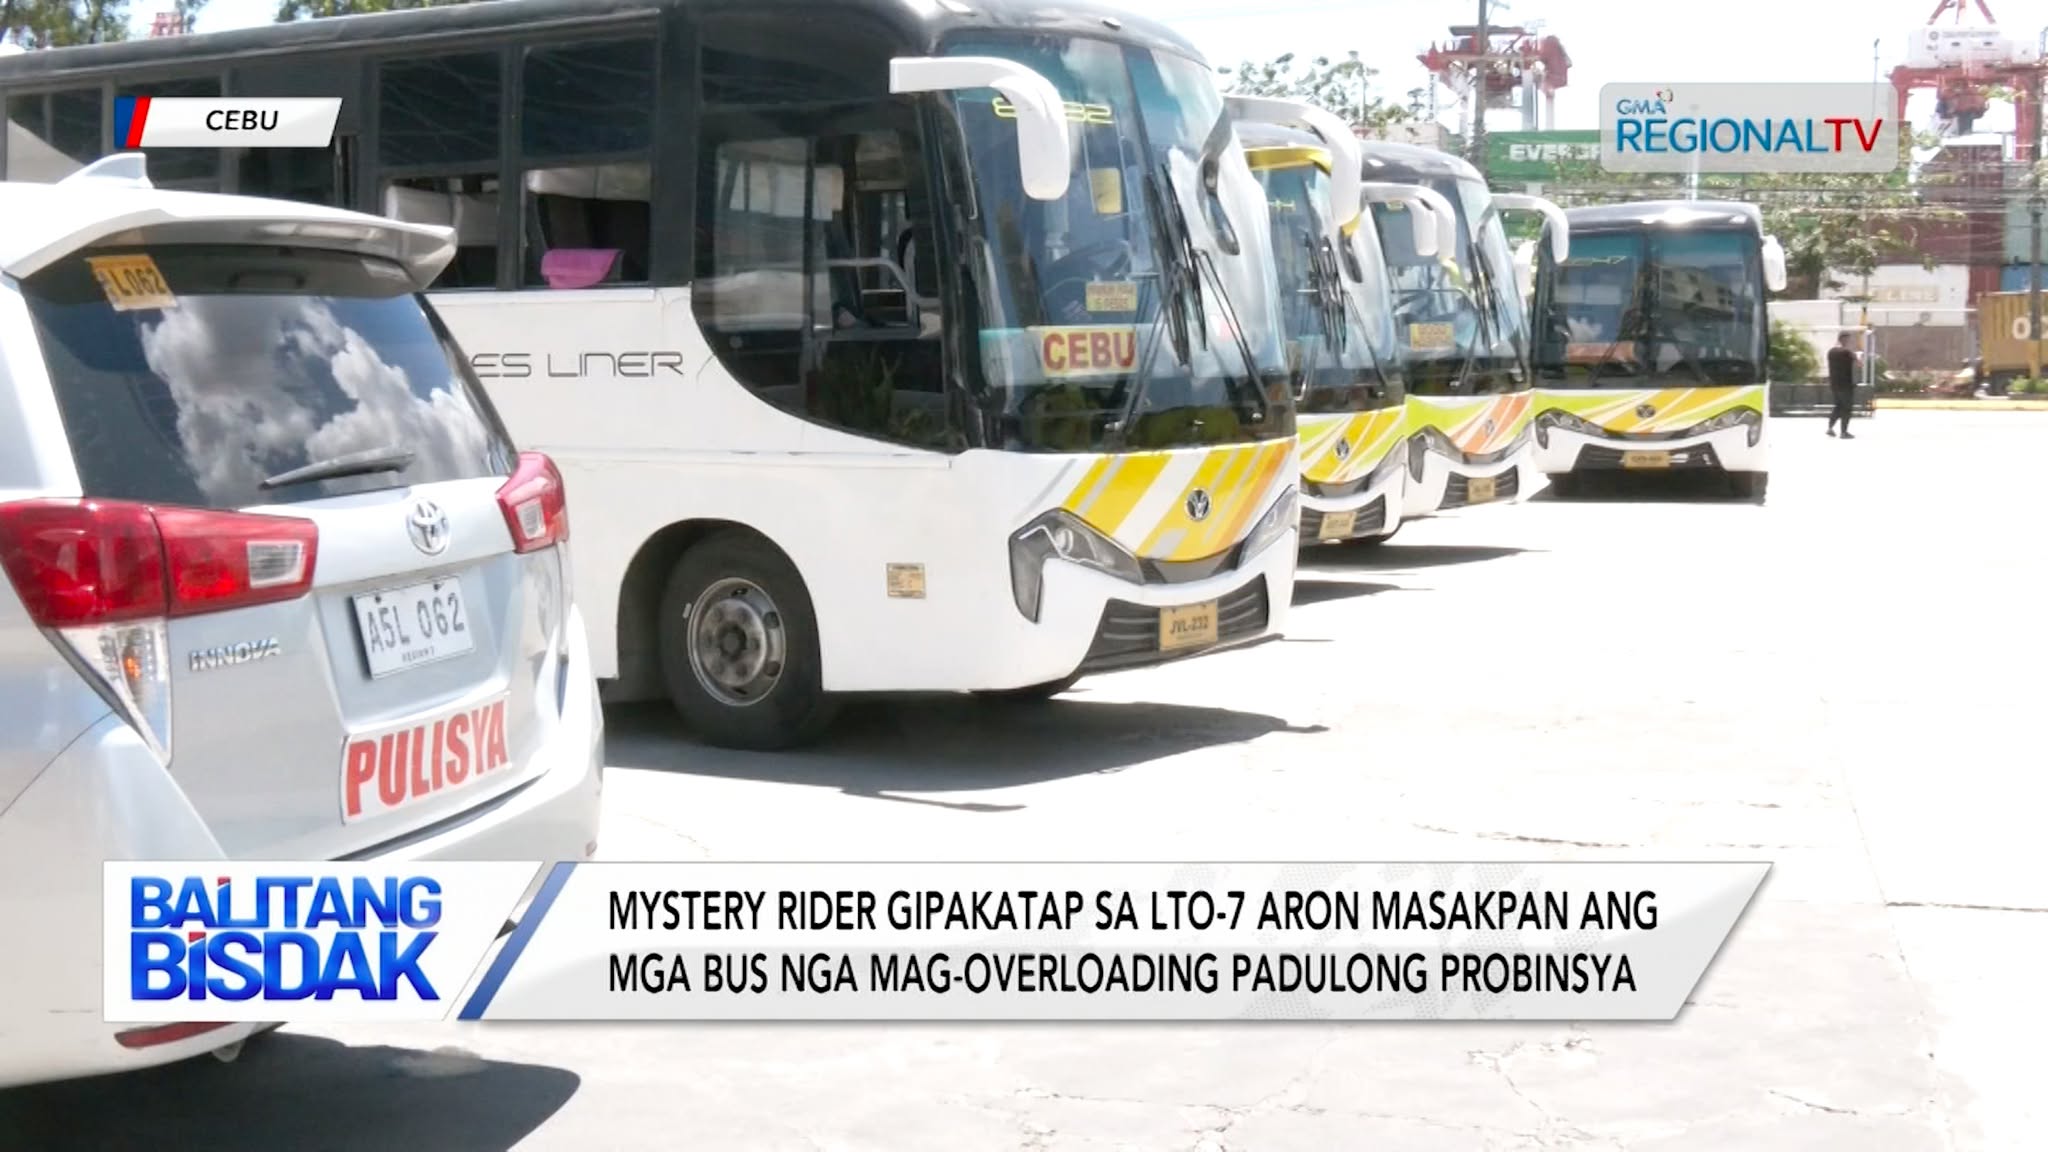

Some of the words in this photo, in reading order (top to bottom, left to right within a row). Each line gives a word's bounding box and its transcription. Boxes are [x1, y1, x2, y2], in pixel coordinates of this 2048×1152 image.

[547, 351, 684, 378] LINER
[1043, 331, 1137, 370] CEBU
[416, 592, 465, 638] 062
[188, 637, 281, 672] INNOVA
[347, 699, 508, 817] PULISYA
